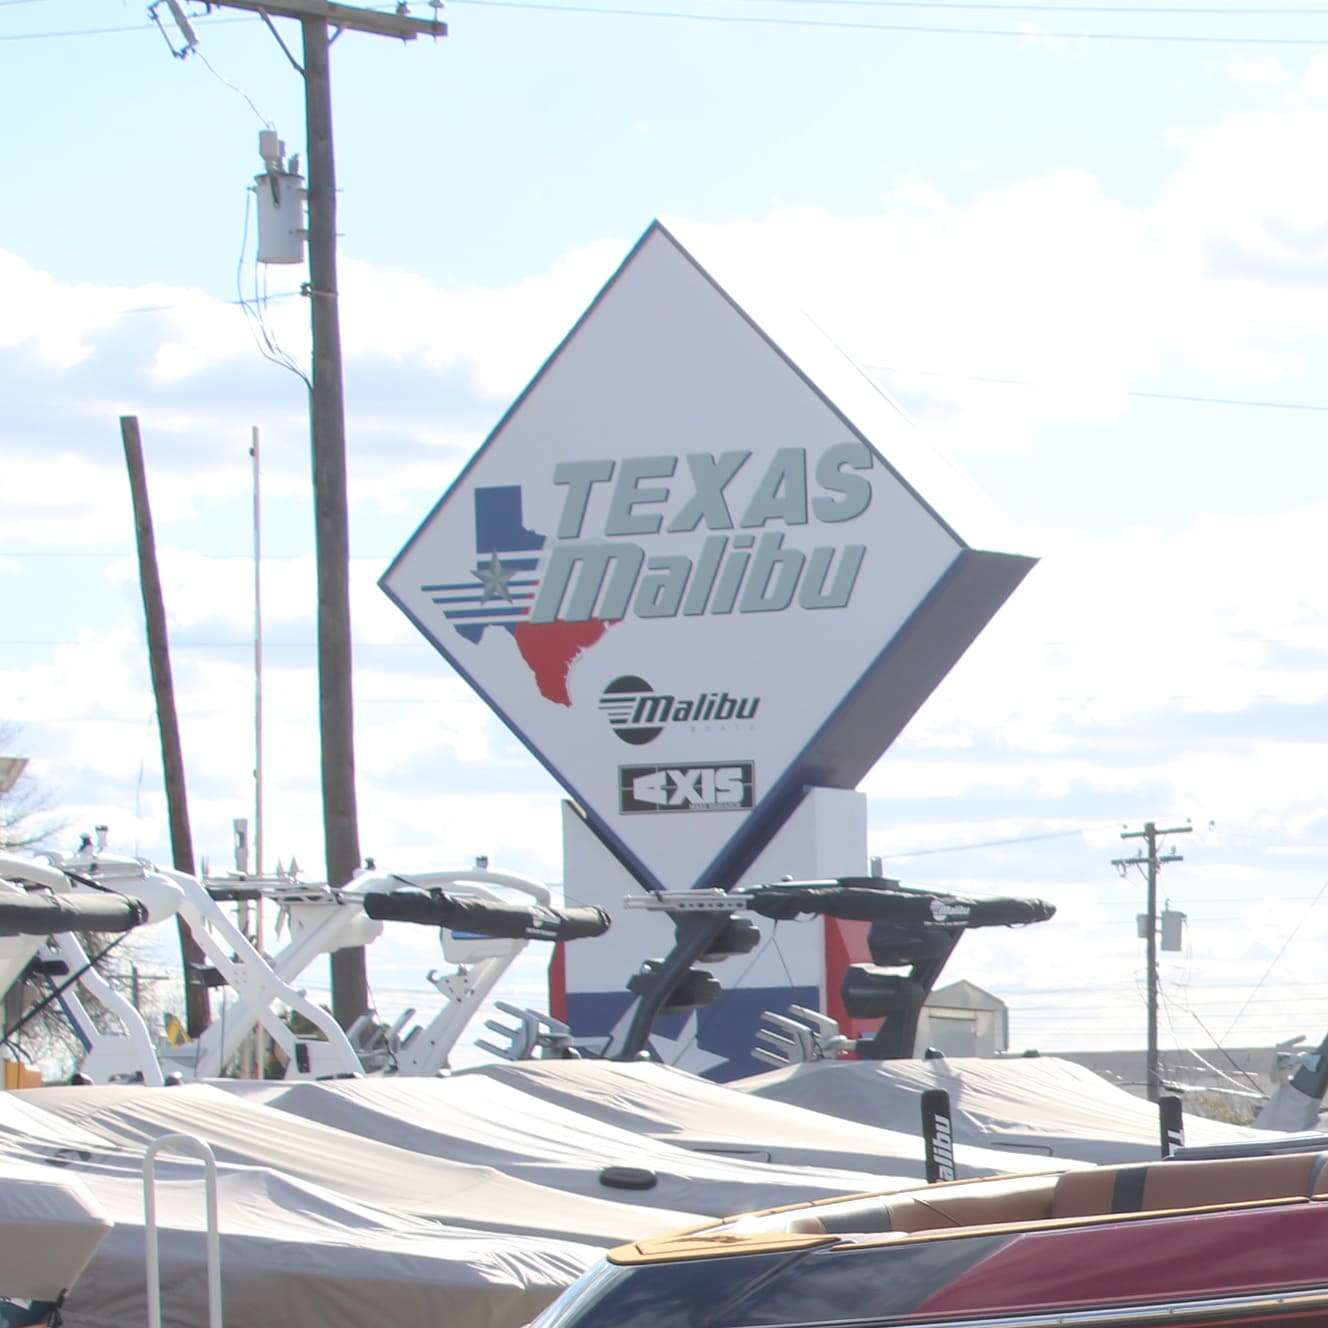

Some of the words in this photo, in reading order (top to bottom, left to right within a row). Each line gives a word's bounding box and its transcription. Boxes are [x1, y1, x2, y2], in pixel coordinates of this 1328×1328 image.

[553, 441, 874, 540] TEXAS
[529, 531, 867, 625] Malibu
[631, 692, 761, 724] Malibu
[632, 766, 745, 806] AXIS
[933, 1113, 955, 1182] alibu
